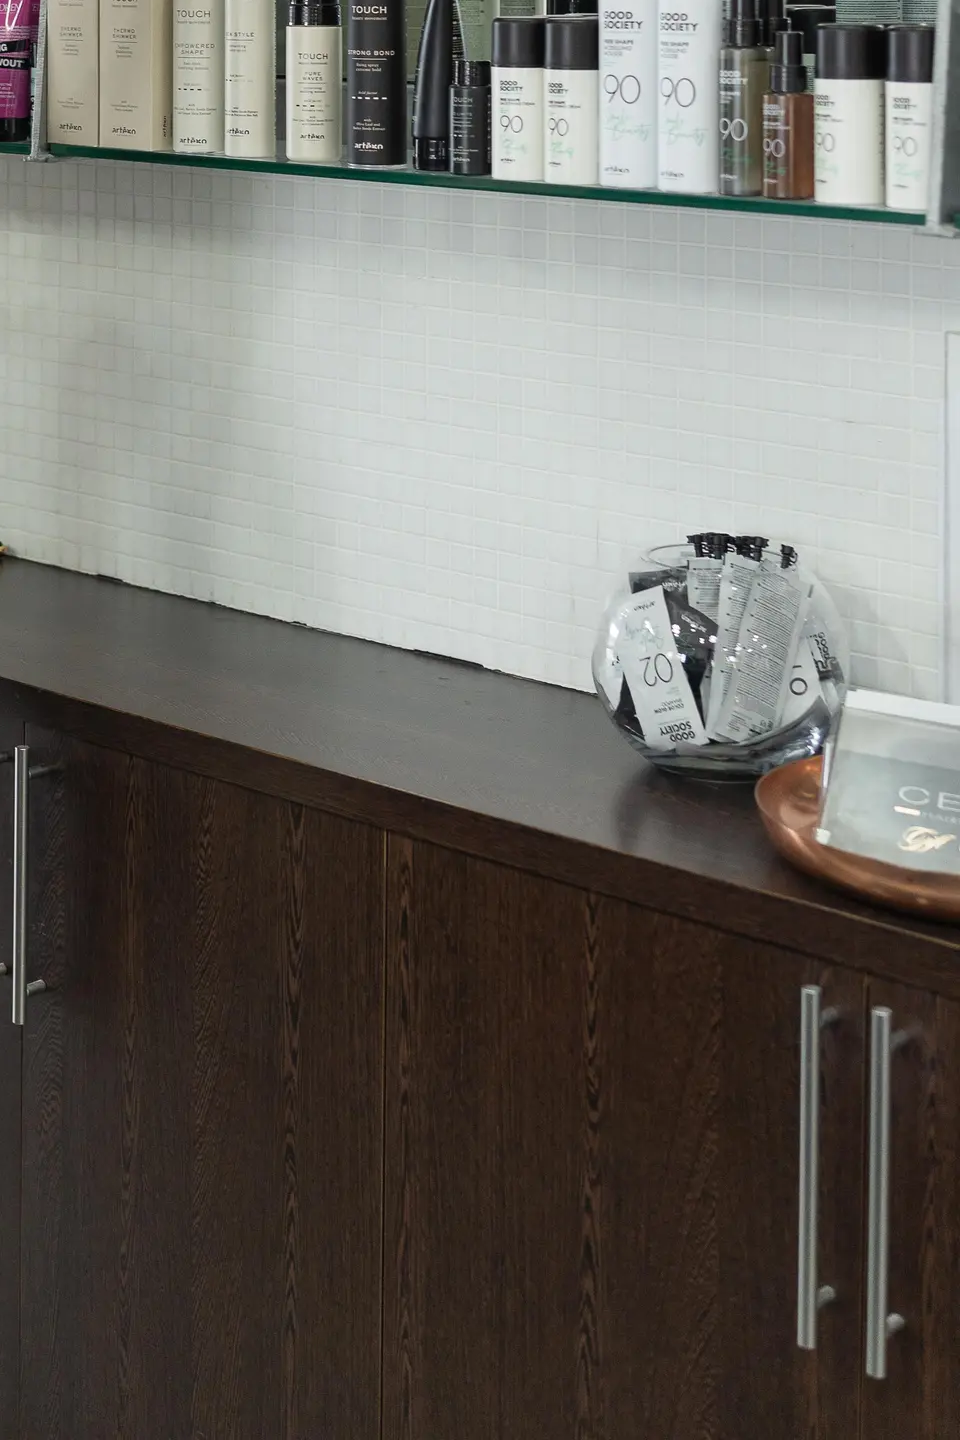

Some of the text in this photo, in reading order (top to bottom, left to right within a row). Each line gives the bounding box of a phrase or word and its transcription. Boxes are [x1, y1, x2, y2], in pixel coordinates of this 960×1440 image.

[176, 9, 211, 18] TOUCH
[352, 5, 388, 14] TOUCH
[298, 52, 329, 60] TOUCH
[604, 74, 641, 104] 90
[660, 77, 696, 108] 90
[499, 115, 523, 133] 90
[548, 117, 569, 136] 90
[719, 118, 748, 141] 90
[762, 138, 785, 157] 90
[892, 135, 918, 157] 90
[639, 653, 673, 687] 02
[659, 720, 692, 737] SOCIETY
[669, 730, 696, 743] GOOD
